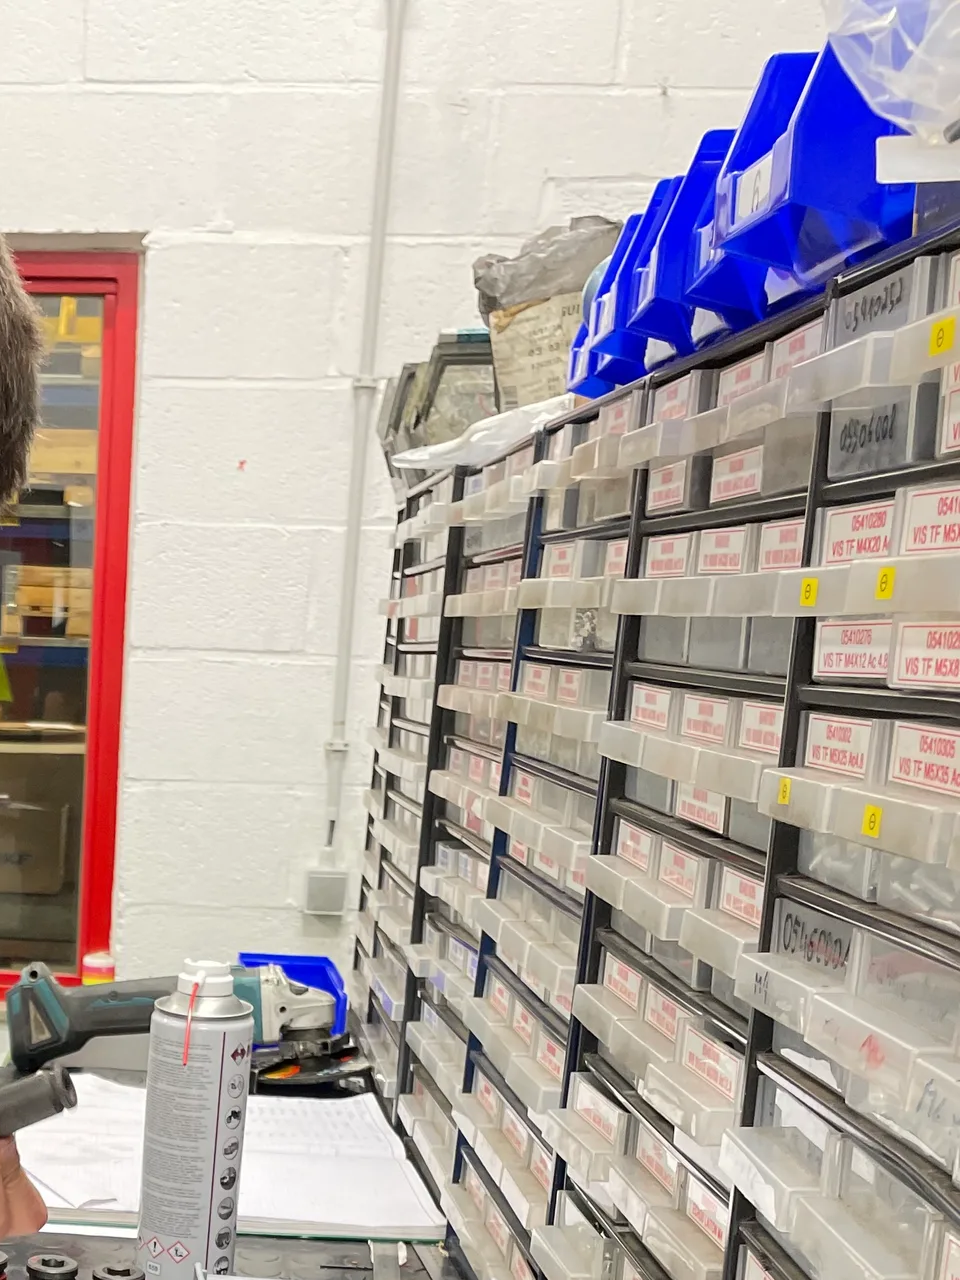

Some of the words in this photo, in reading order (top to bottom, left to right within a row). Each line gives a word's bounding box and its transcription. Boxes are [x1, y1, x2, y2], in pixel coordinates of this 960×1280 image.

[937, 496, 960, 516] 0541
[913, 525, 928, 545] VIS
[930, 524, 942, 544] TF
[832, 540, 844, 557] VIS
[845, 538, 855, 556] TF
[823, 652, 834, 669] VIS
[835, 652, 843, 668] TF
[905, 656, 919, 676] VIS
[921, 656, 933, 676] TF
[811, 744, 821, 761] VIS
[822, 746, 829, 761] TF
[898, 756, 911, 777] VIS
[912, 759, 923, 778] TF
